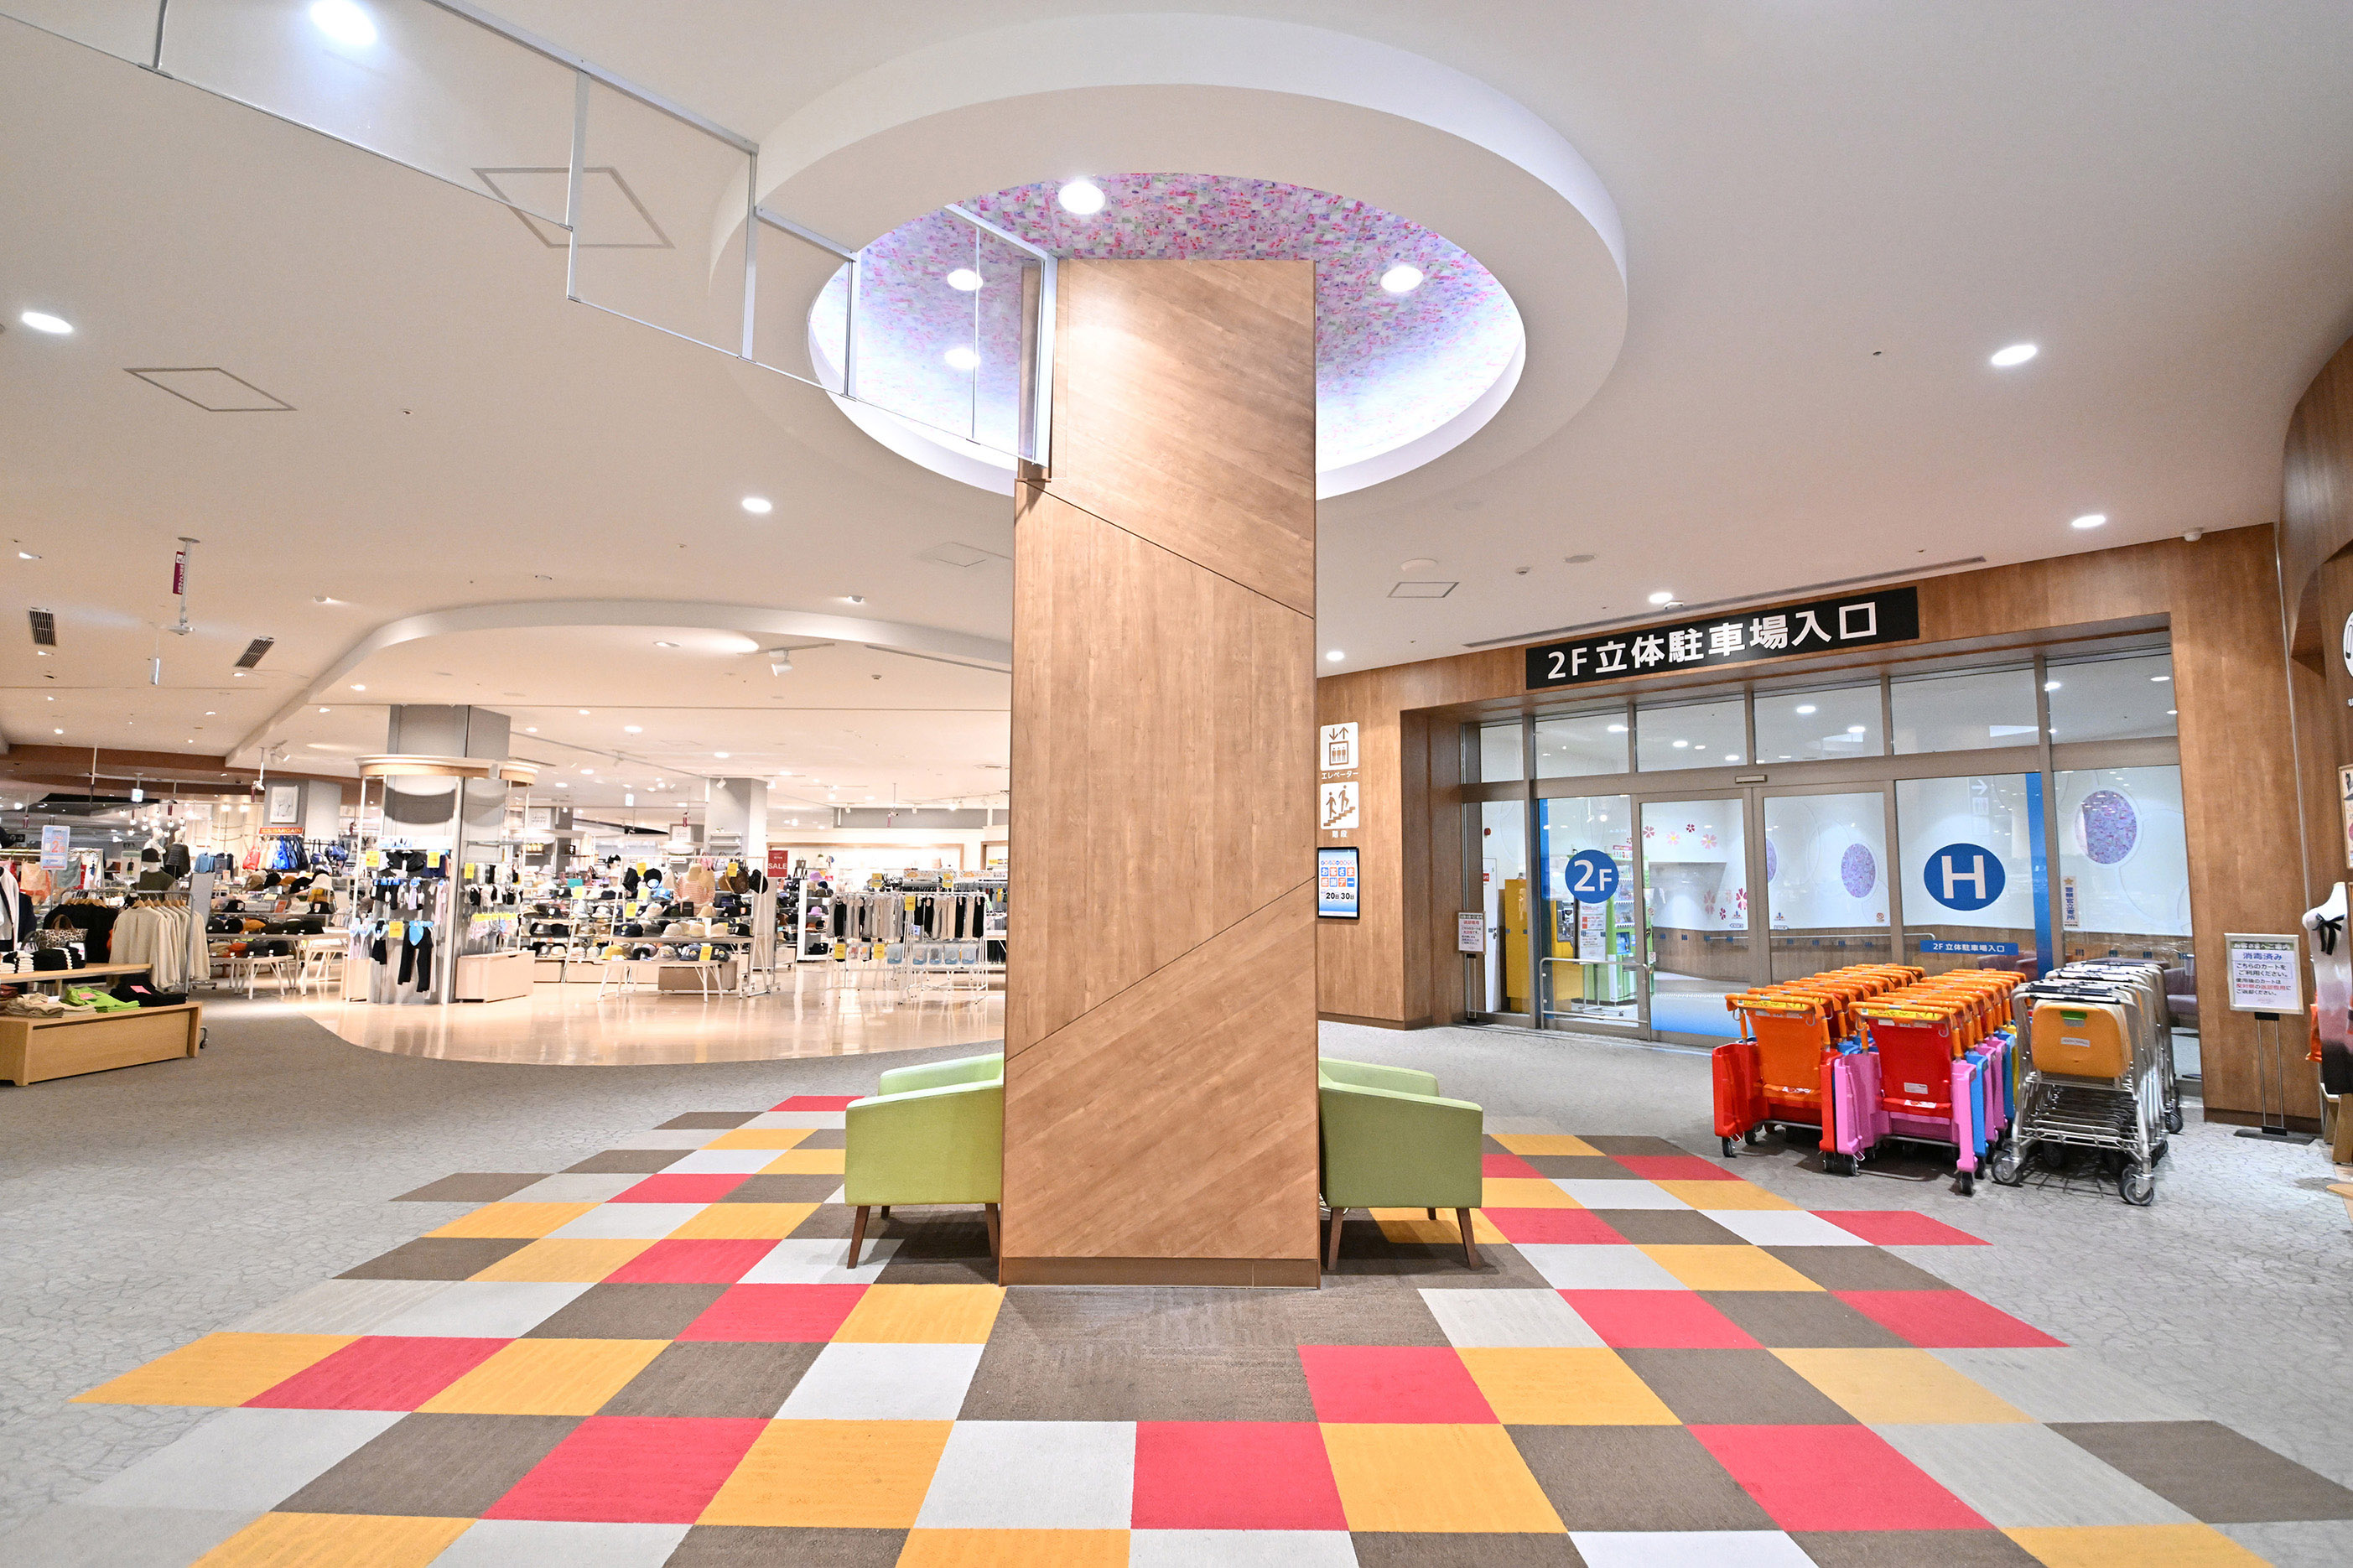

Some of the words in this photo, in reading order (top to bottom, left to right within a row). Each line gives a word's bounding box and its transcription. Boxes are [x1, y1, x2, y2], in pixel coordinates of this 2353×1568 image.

[1322, 771, 1358, 780] エレベーター
[1574, 859, 1613, 892] 2F
[1941, 854, 1987, 900] H
[2243, 953, 2283, 961] 消毒済み
